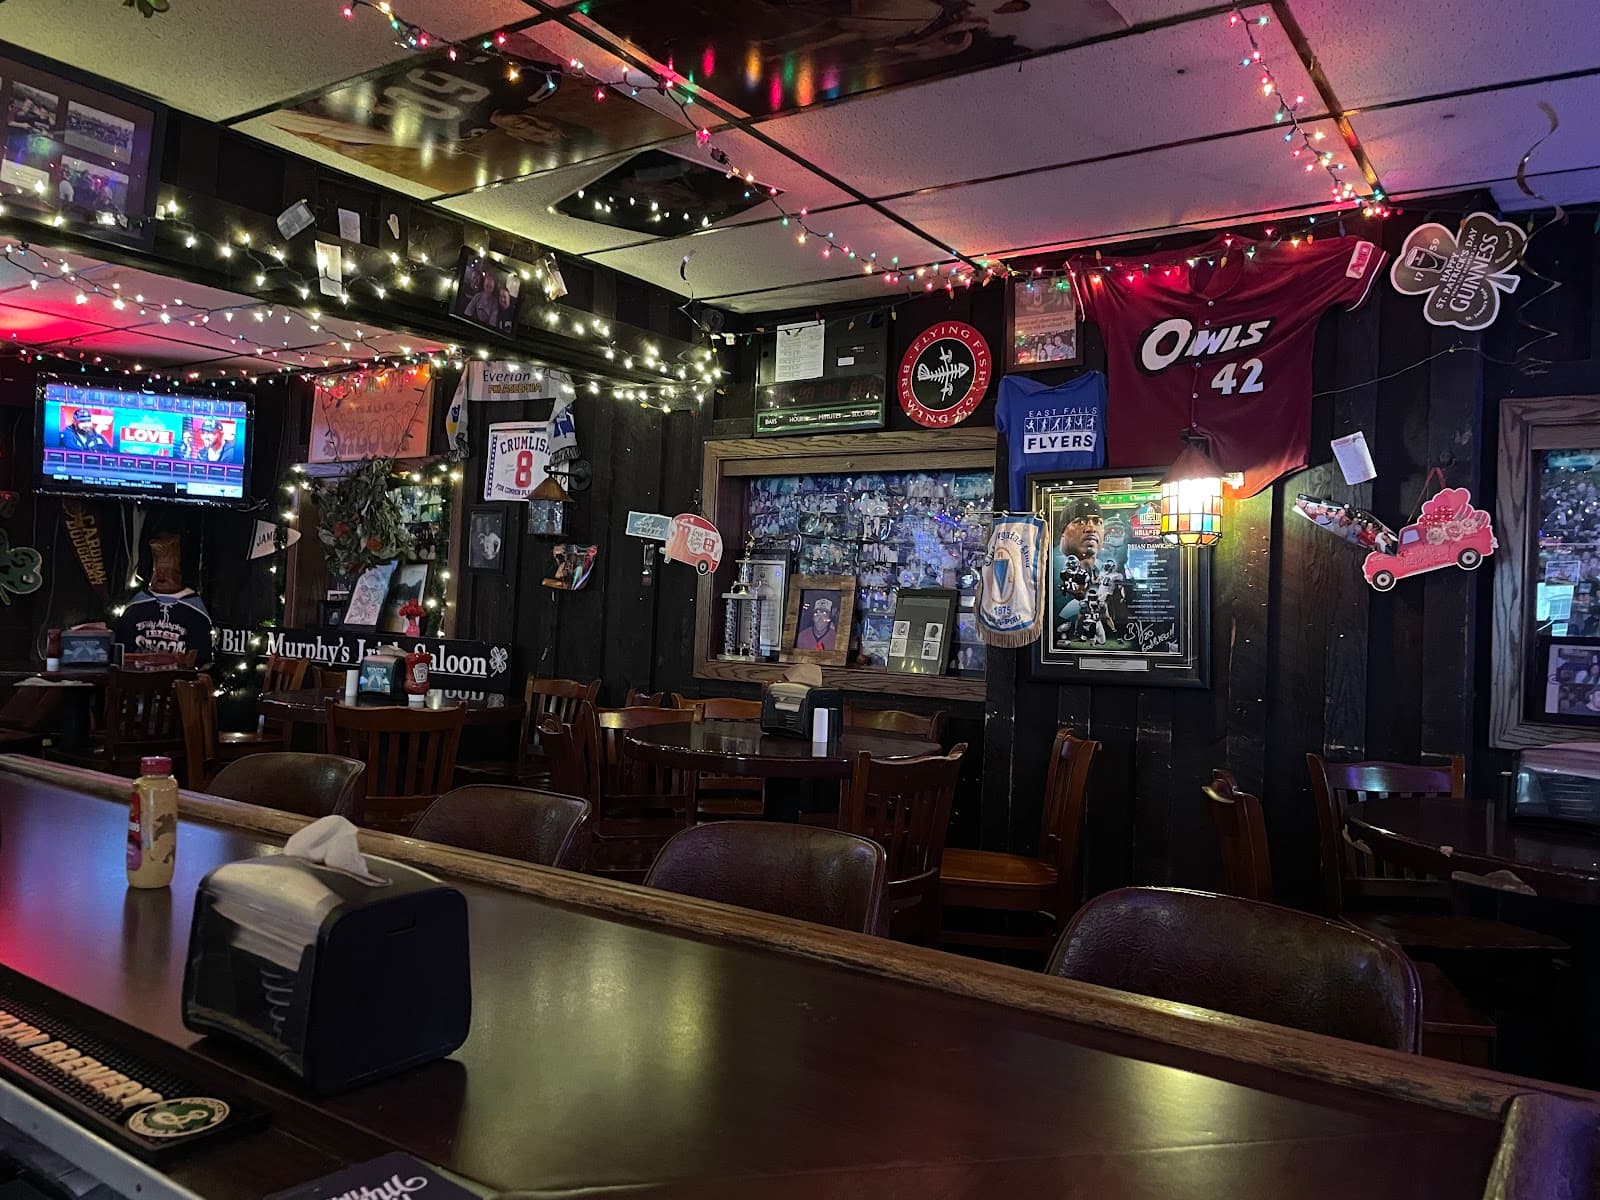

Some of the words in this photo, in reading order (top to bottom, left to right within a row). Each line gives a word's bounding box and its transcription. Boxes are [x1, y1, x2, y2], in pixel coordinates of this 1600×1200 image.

[1430, 238, 1440, 251] 59
[1414, 271, 1424, 281] 17
[1436, 296, 1448, 309] ST.
[1446, 249, 1470, 294] PATRICK'S
[1465, 227, 1478, 247] DAY
[1440, 252, 1460, 282] HAPPY
[1450, 233, 1499, 312] GUINNESS
[913, 326, 970, 352] FLYING
[973, 340, 987, 385] FISH
[483, 369, 530, 382] Everton
[1211, 358, 1264, 395] 42
[901, 364, 948, 423] BREWING
[1029, 408, 1057, 418] EAST
[1063, 407, 1097, 415] FALLS
[124, 427, 170, 443] LOVE
[1028, 435, 1093, 450] FLYERS
[514, 450, 533, 488] 8
[82, 514, 109, 582] CARDINAL
[256, 531, 276, 547] JAM
[994, 605, 1012, 615] 1875
[222, 628, 257, 653] Bill
[265, 631, 350, 666] Murphy's
[356, 639, 398, 664] Iri
[0, 1010, 50, 1048] YN
[30, 1040, 164, 1109] BREWERY
